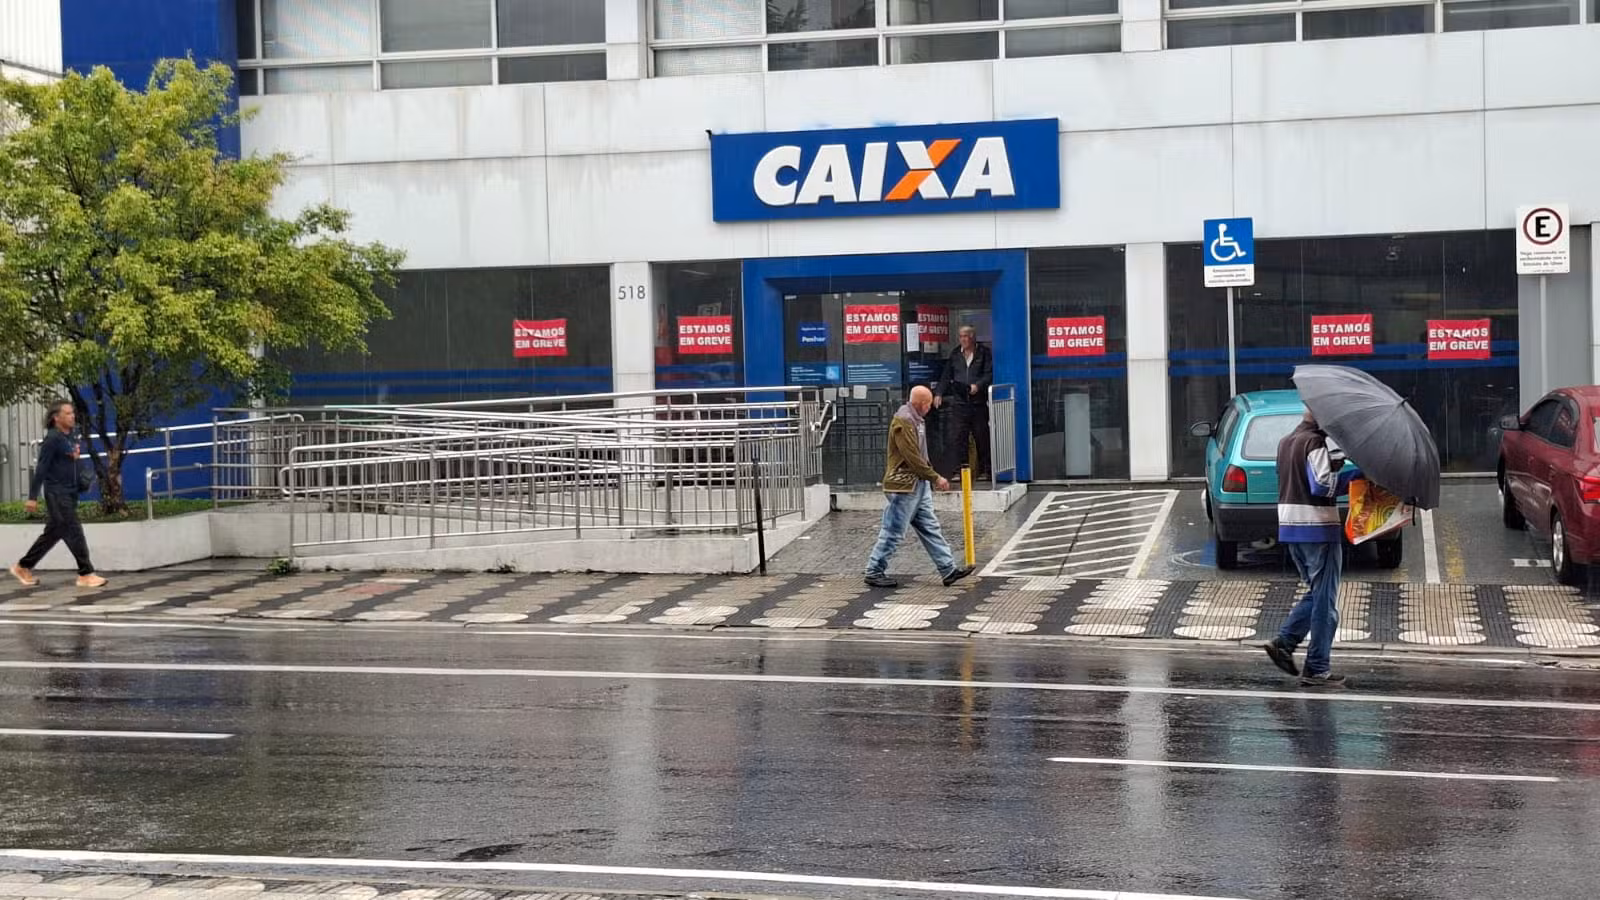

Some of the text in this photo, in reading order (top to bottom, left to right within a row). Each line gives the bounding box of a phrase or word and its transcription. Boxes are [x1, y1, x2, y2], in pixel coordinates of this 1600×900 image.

[753, 136, 1015, 206] CAIXA
[1535, 216, 1550, 238] E
[618, 285, 646, 300] 518
[846, 313, 898, 322] ESTAMOS
[679, 324, 731, 334] ESTAMOS
[846, 325, 899, 334] EM GREVE
[1048, 325, 1104, 336] ESTAMOS
[1312, 323, 1371, 334] ESTAMOS
[1429, 328, 1489, 338] ESTAMOS
[514, 338, 566, 349] EM GREVE
[680, 336, 732, 346] EM GREVE
[1049, 337, 1104, 348] EM GREVE
[1313, 335, 1371, 346] EM GREVE
[1429, 340, 1489, 351] EM GREVE
